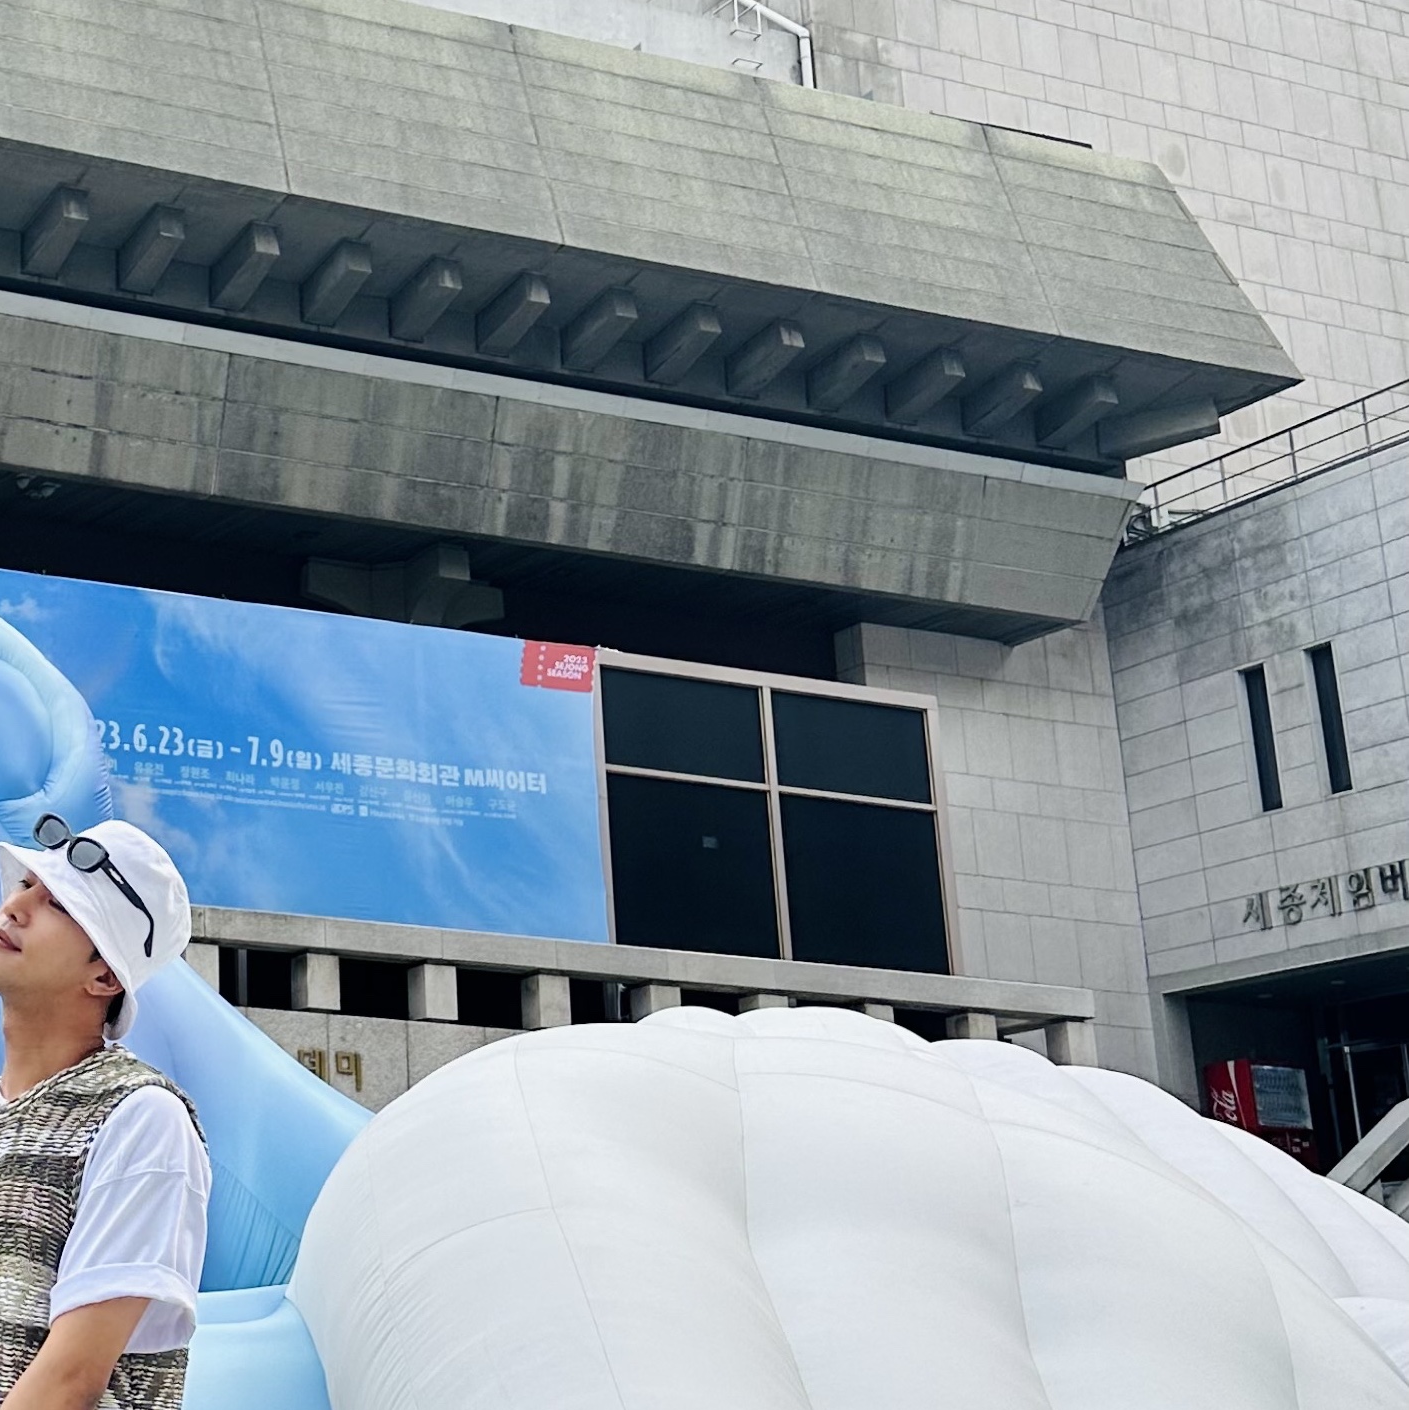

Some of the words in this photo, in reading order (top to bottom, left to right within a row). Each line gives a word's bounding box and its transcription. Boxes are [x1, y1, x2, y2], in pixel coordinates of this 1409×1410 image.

[563, 654, 588, 664] 2023
[555, 661, 589, 673] SEJONG
[547, 668, 582, 680] SEASON
[331, 752, 461, 788] 세종문화회관
[464, 768, 547, 794] M씨어터
